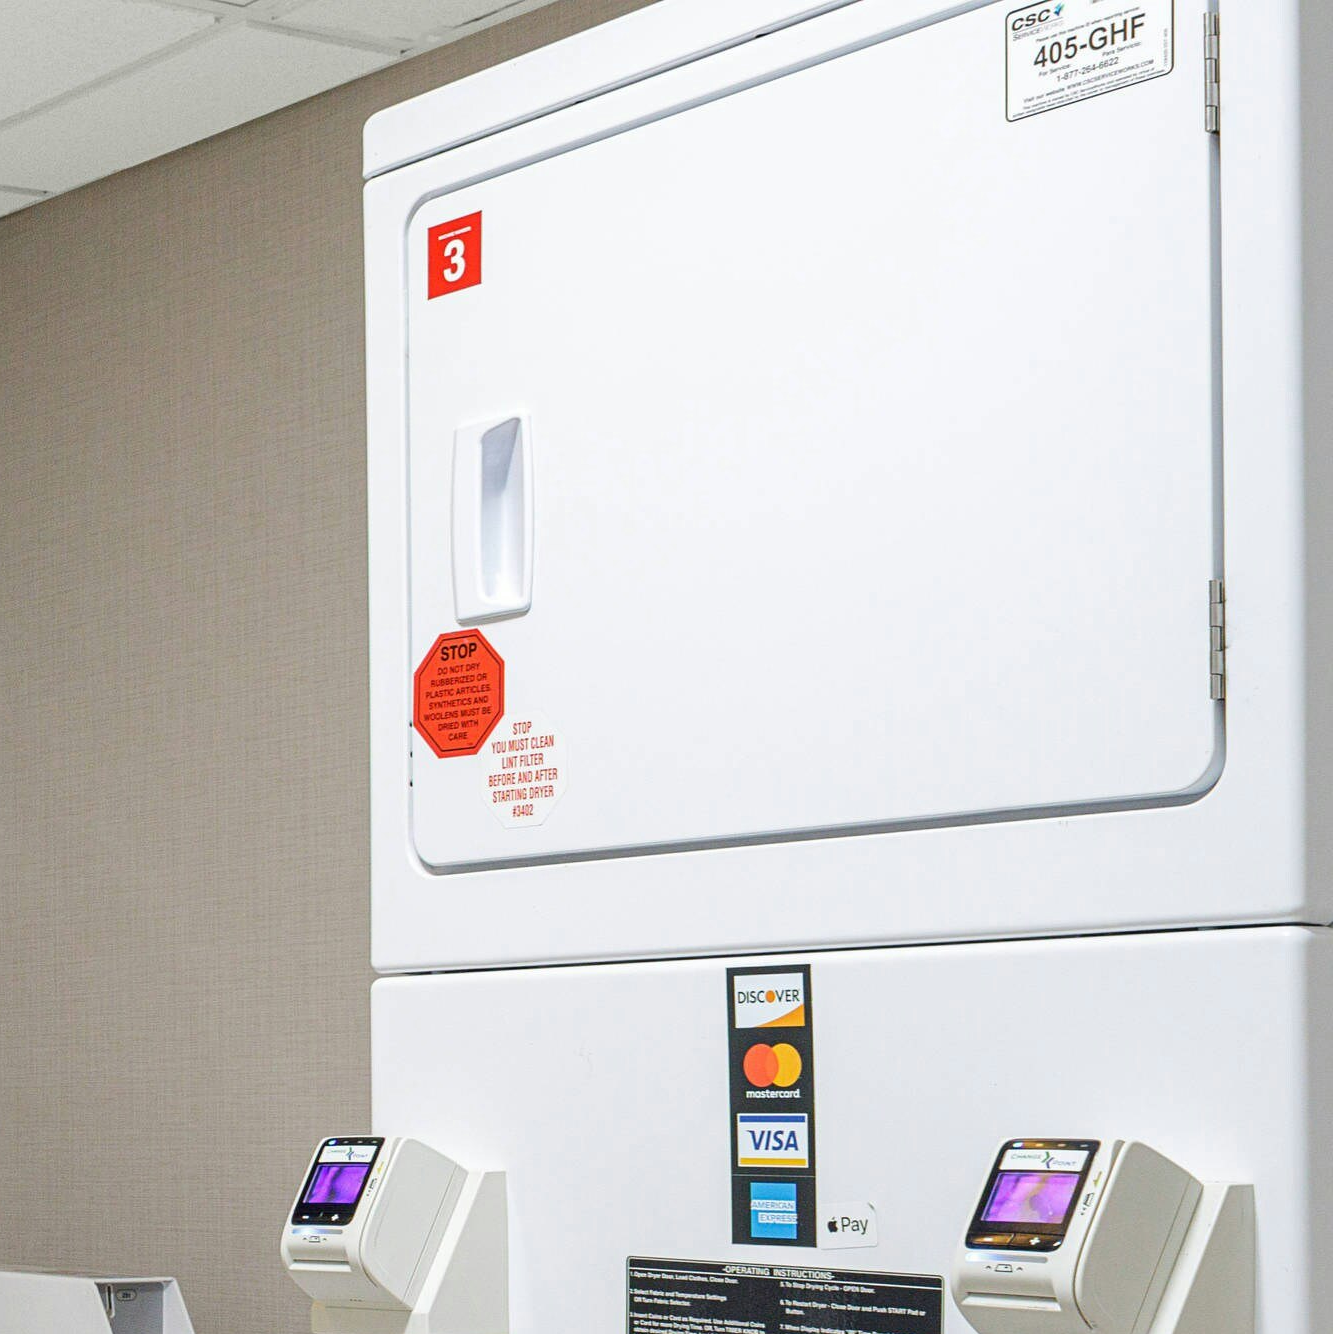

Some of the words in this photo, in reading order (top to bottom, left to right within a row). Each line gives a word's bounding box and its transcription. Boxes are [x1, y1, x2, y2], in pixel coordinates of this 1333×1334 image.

[1012, 9, 1050, 31] CSC
[1033, 13, 1145, 68] 405-GHF
[444, 239, 465, 282] 3
[441, 643, 477, 661] STOP
[438, 667, 447, 675] DO
[450, 665, 463, 673] NOT
[466, 663, 480, 671] DRY
[431, 675, 475, 687] RUBBERIZED
[477, 673, 487, 681] OR
[426, 689, 454, 698] PLASTIC
[429, 698, 471, 710] SYNTHETICS
[474, 696, 488, 704] AND
[424, 711, 458, 720] WOOLENS
[461, 708, 479, 717] MUST
[482, 706, 491, 714] BE
[438, 722, 459, 731] DRIED
[513, 722, 531, 735] STOP
[448, 732, 468, 741] CARE
[492, 741, 506, 753] YOU
[508, 738, 528, 751] MUST
[531, 735, 554, 749] CLEAN
[502, 757, 517, 769] LINT
[520, 753, 544, 767] FILTER
[489, 773, 516, 787] BEFORE
[518, 771, 533, 782] AND
[535, 768, 558, 781] AFTER
[493, 788, 527, 803] STARTING
[529, 786, 554, 799] DRYER
[512, 804, 533, 817] #3402
[738, 990, 800, 1003] DISCOVER
[746, 1089, 800, 1098] mastercard
[747, 1130, 799, 1151] VISA
[760, 1214, 797, 1222] EXPRESS
[841, 1216, 868, 1235] Pay
